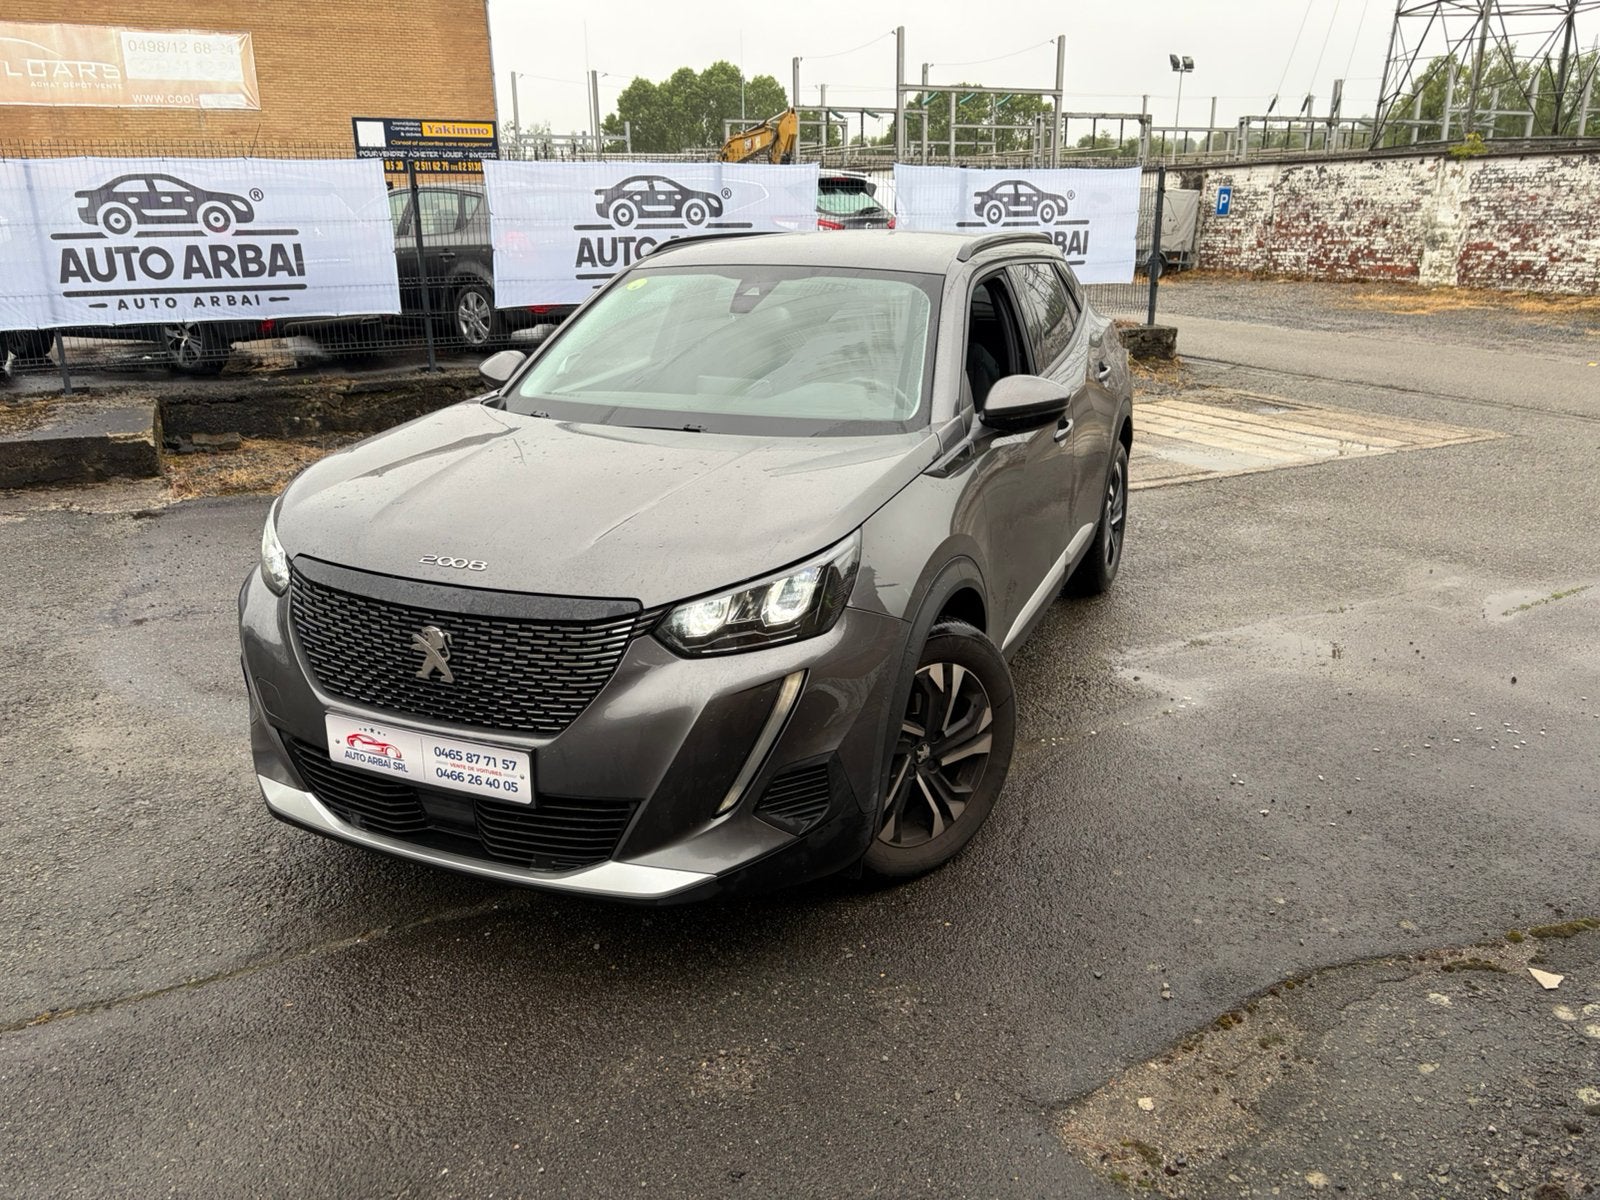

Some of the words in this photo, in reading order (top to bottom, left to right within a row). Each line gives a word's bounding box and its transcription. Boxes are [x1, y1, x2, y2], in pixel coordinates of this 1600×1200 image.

[127, 39, 188, 54] 0498/12
[426, 124, 489, 136] Yakimmo
[1218, 193, 1229, 210] P
[1041, 230, 1090, 256] BAI
[59, 245, 175, 284] AUTO
[182, 242, 306, 280] ARBAI
[117, 296, 178, 311] AUTO
[193, 294, 261, 308] ARBAI
[419, 554, 488, 571] 2008
[344, 750, 366, 763] AUTO
[392, 761, 409, 773] SRL
[433, 746, 463, 762] 0465
[465, 752, 481, 765] 87
[483, 755, 497, 768] 71
[501, 758, 517, 771] 57
[449, 762, 466, 771] VENTE
[475, 767, 502, 777] VOITURES
[435, 767, 465, 782] 0466
[467, 773, 483, 786] 26
[485, 777, 500, 789] 40
[503, 780, 519, 793] 05
